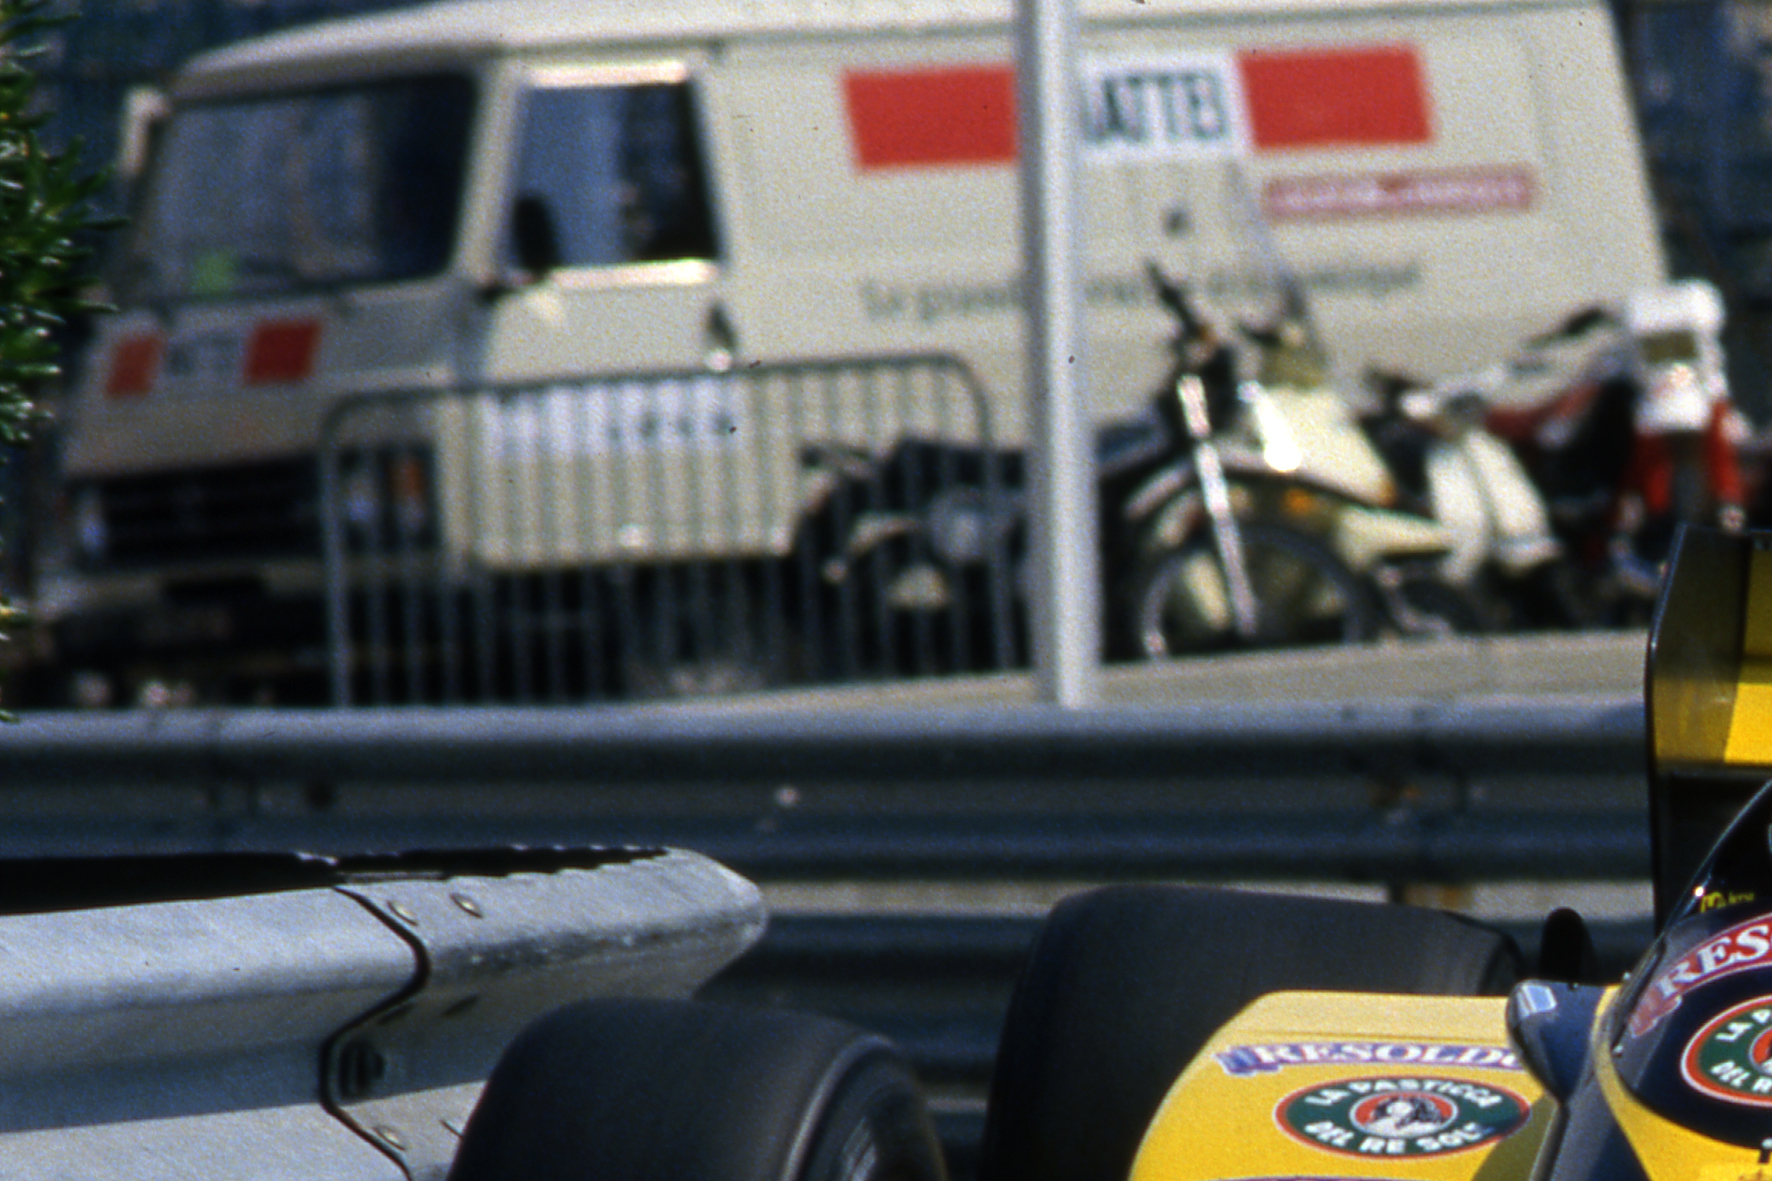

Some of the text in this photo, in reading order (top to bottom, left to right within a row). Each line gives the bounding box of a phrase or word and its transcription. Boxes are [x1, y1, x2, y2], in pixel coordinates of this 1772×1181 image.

[1716, 1017, 1751, 1044] LA
[1253, 1044, 1517, 1067] RESOLD
[1709, 1059, 1751, 1089] DEL
[1359, 1137, 1406, 1154] RE
